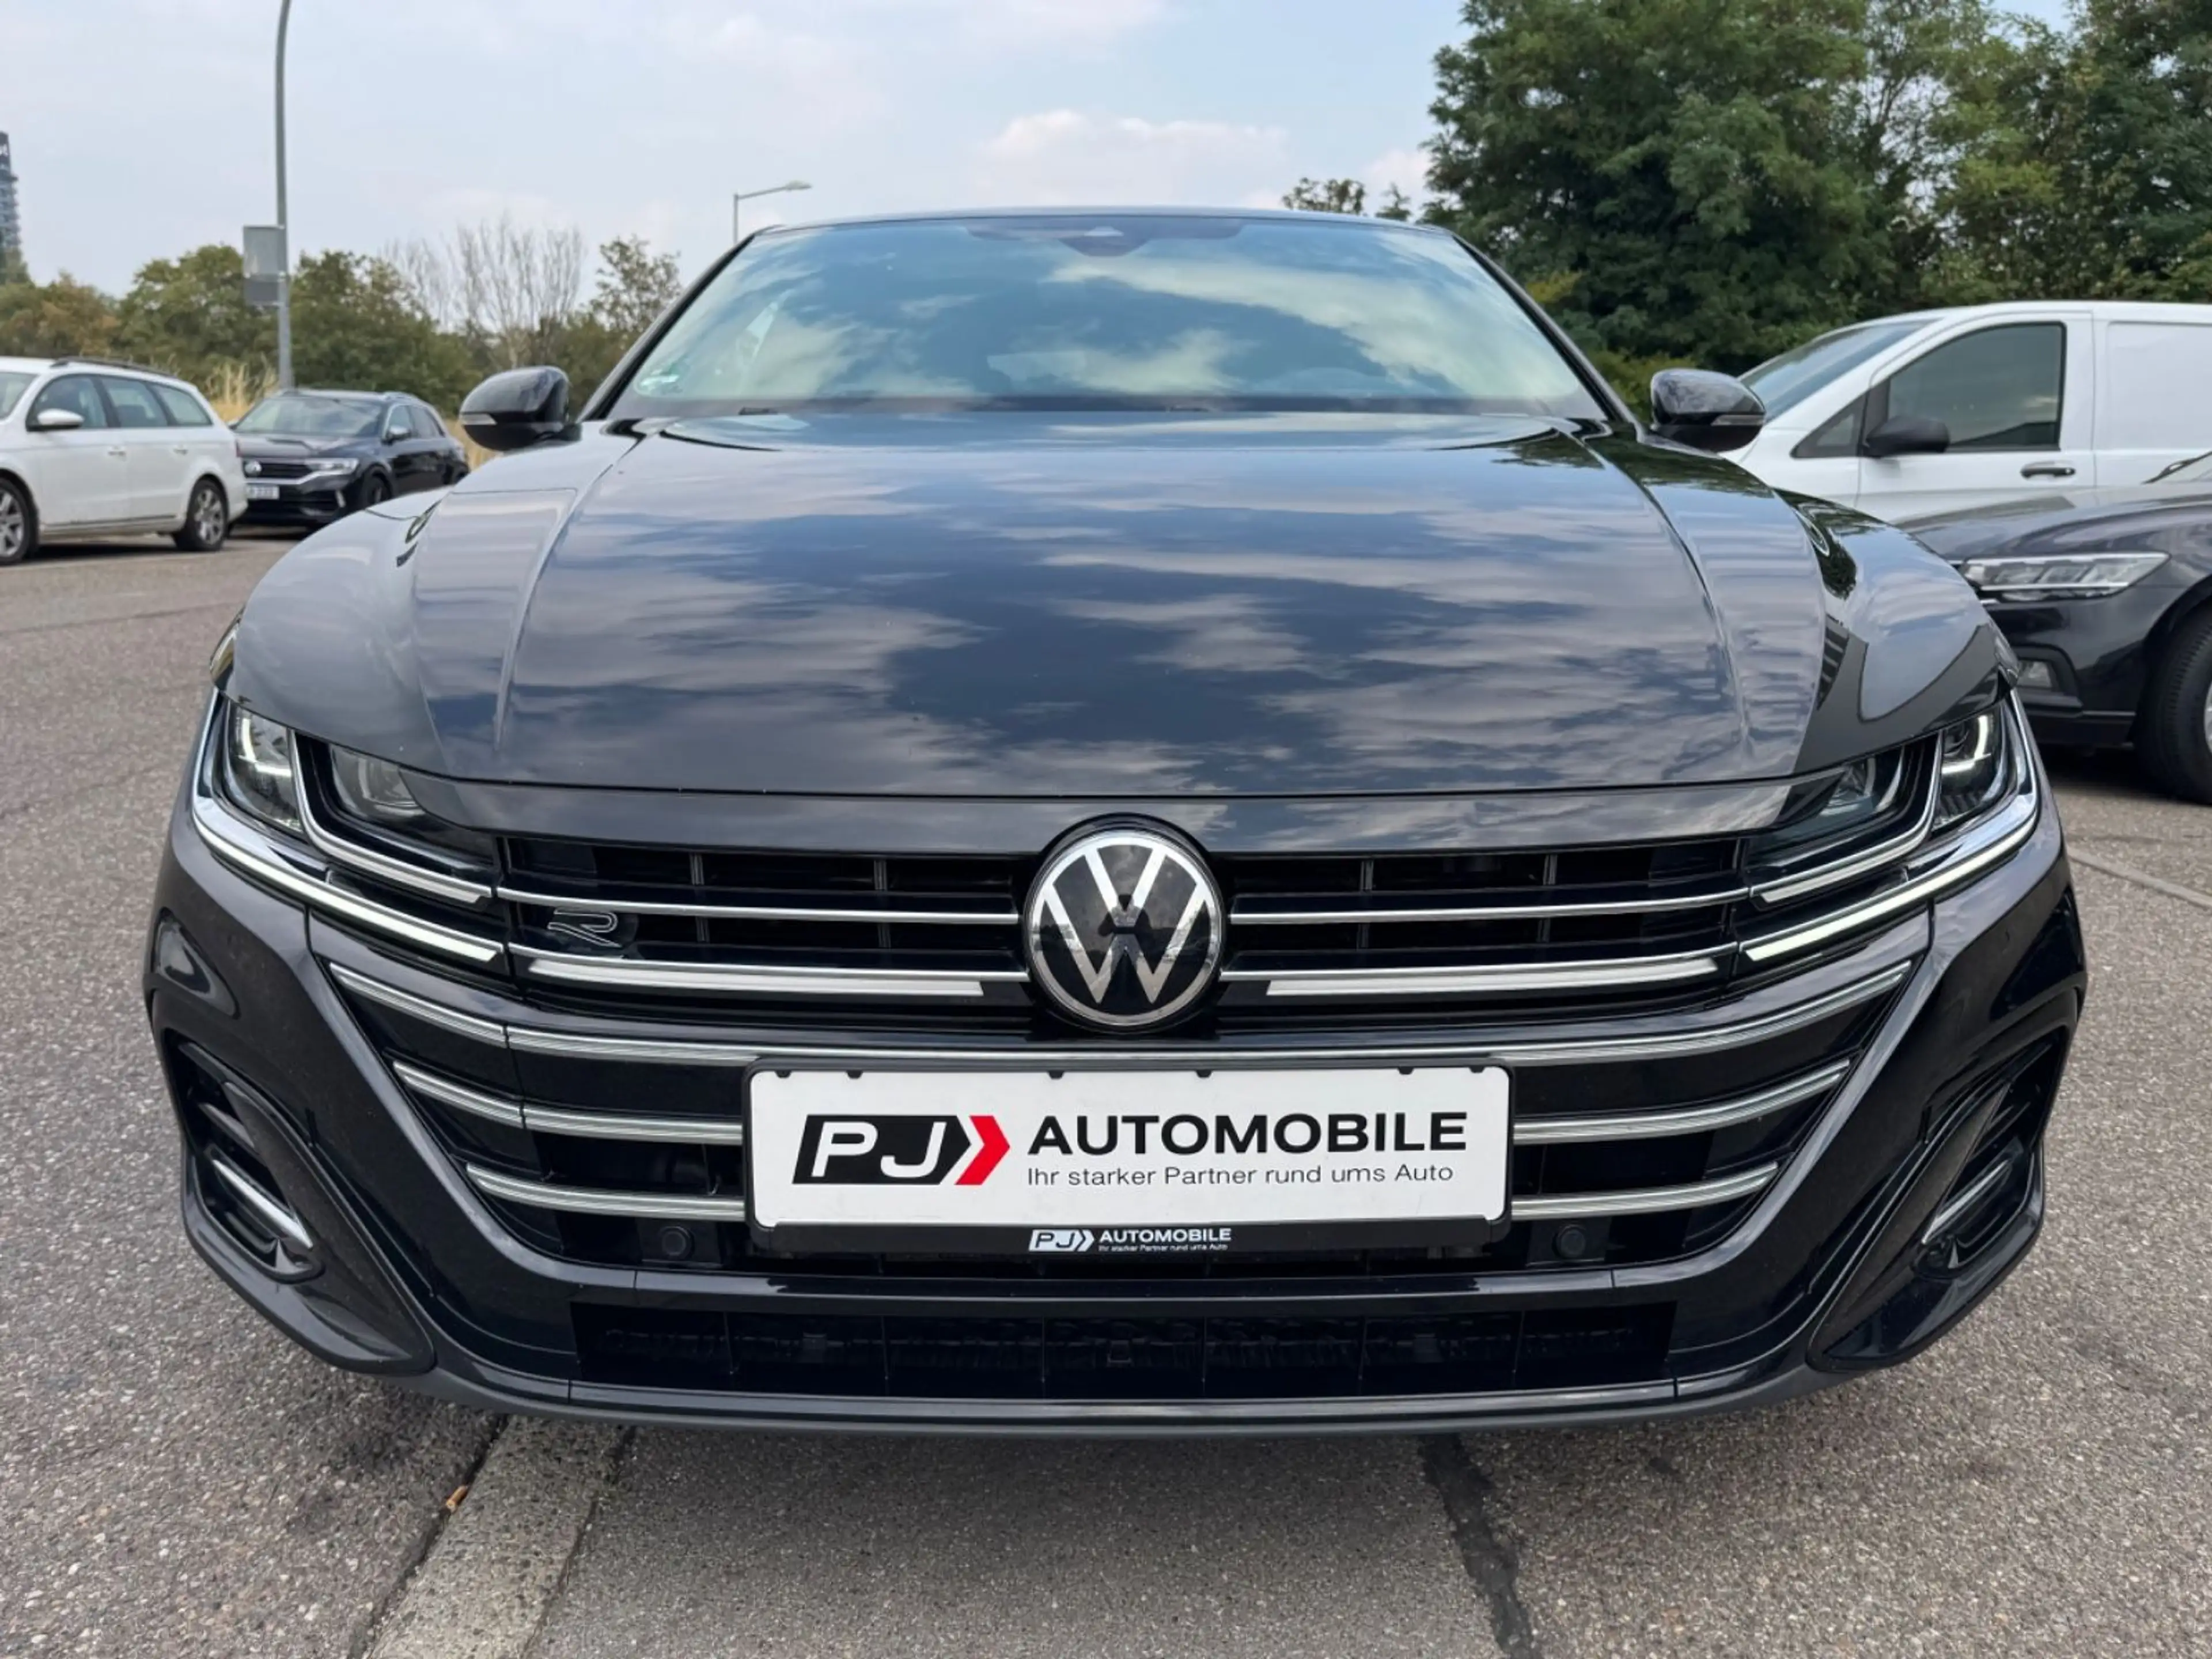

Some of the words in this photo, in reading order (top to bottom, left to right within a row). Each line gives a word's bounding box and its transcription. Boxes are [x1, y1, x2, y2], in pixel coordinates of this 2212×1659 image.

[547, 907, 623, 948] R
[811, 1121, 946, 1178] PJ
[1028, 1112, 1468, 1156] AUTOMOBILE
[1028, 1168, 1060, 1185] Ihr
[1068, 1168, 1157, 1186] starker
[1164, 1166, 1257, 1185] Partner
[1265, 1165, 1321, 1184] rund
[1331, 1167, 1386, 1183] ums
[1394, 1163, 1453, 1181] Auto
[1035, 1232, 1075, 1248] PJ
[1100, 1228, 1233, 1244] AUTOMOBILE
